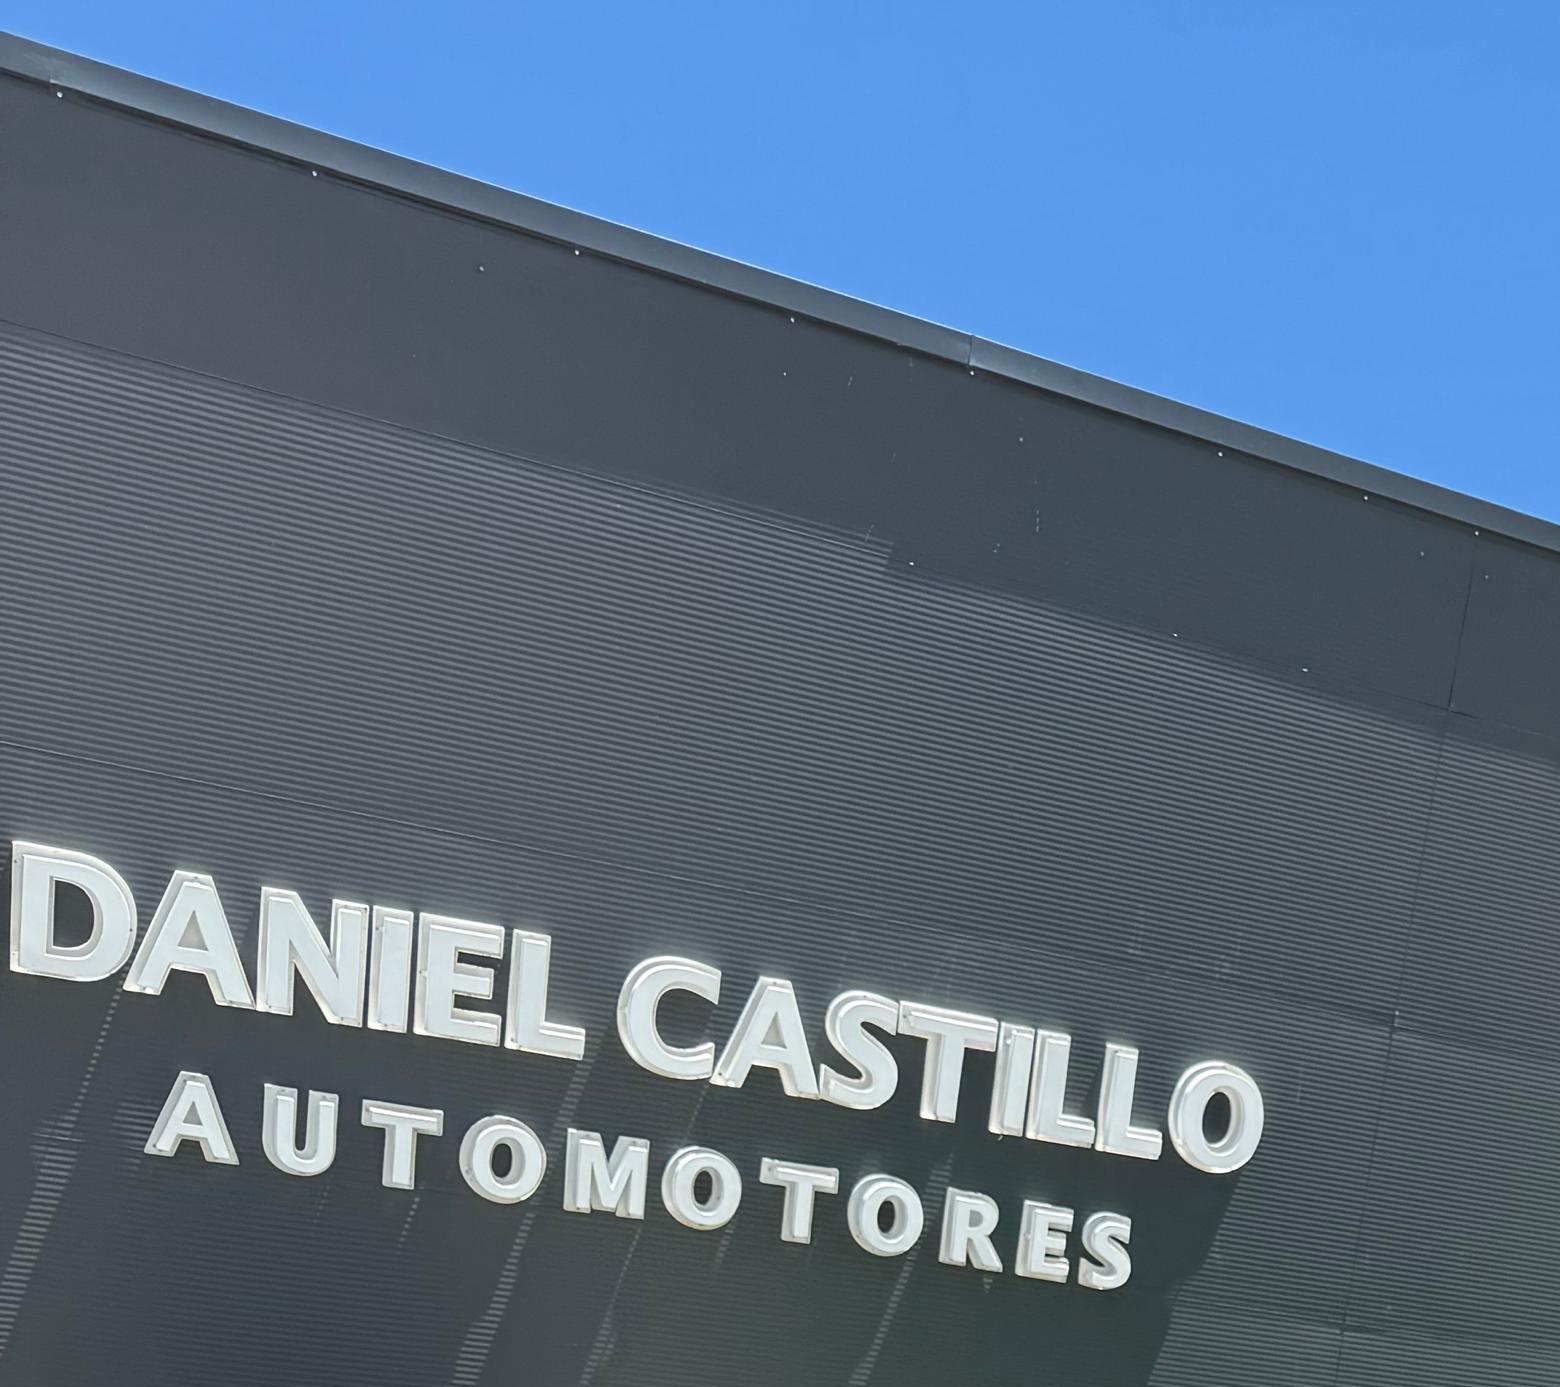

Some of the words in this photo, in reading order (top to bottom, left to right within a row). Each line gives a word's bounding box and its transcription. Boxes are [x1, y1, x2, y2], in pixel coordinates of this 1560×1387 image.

[10, 841, 586, 1060] DANIEL
[617, 955, 1264, 1173] CASTILLO
[144, 1071, 1132, 1290] AUTOMOTORES
